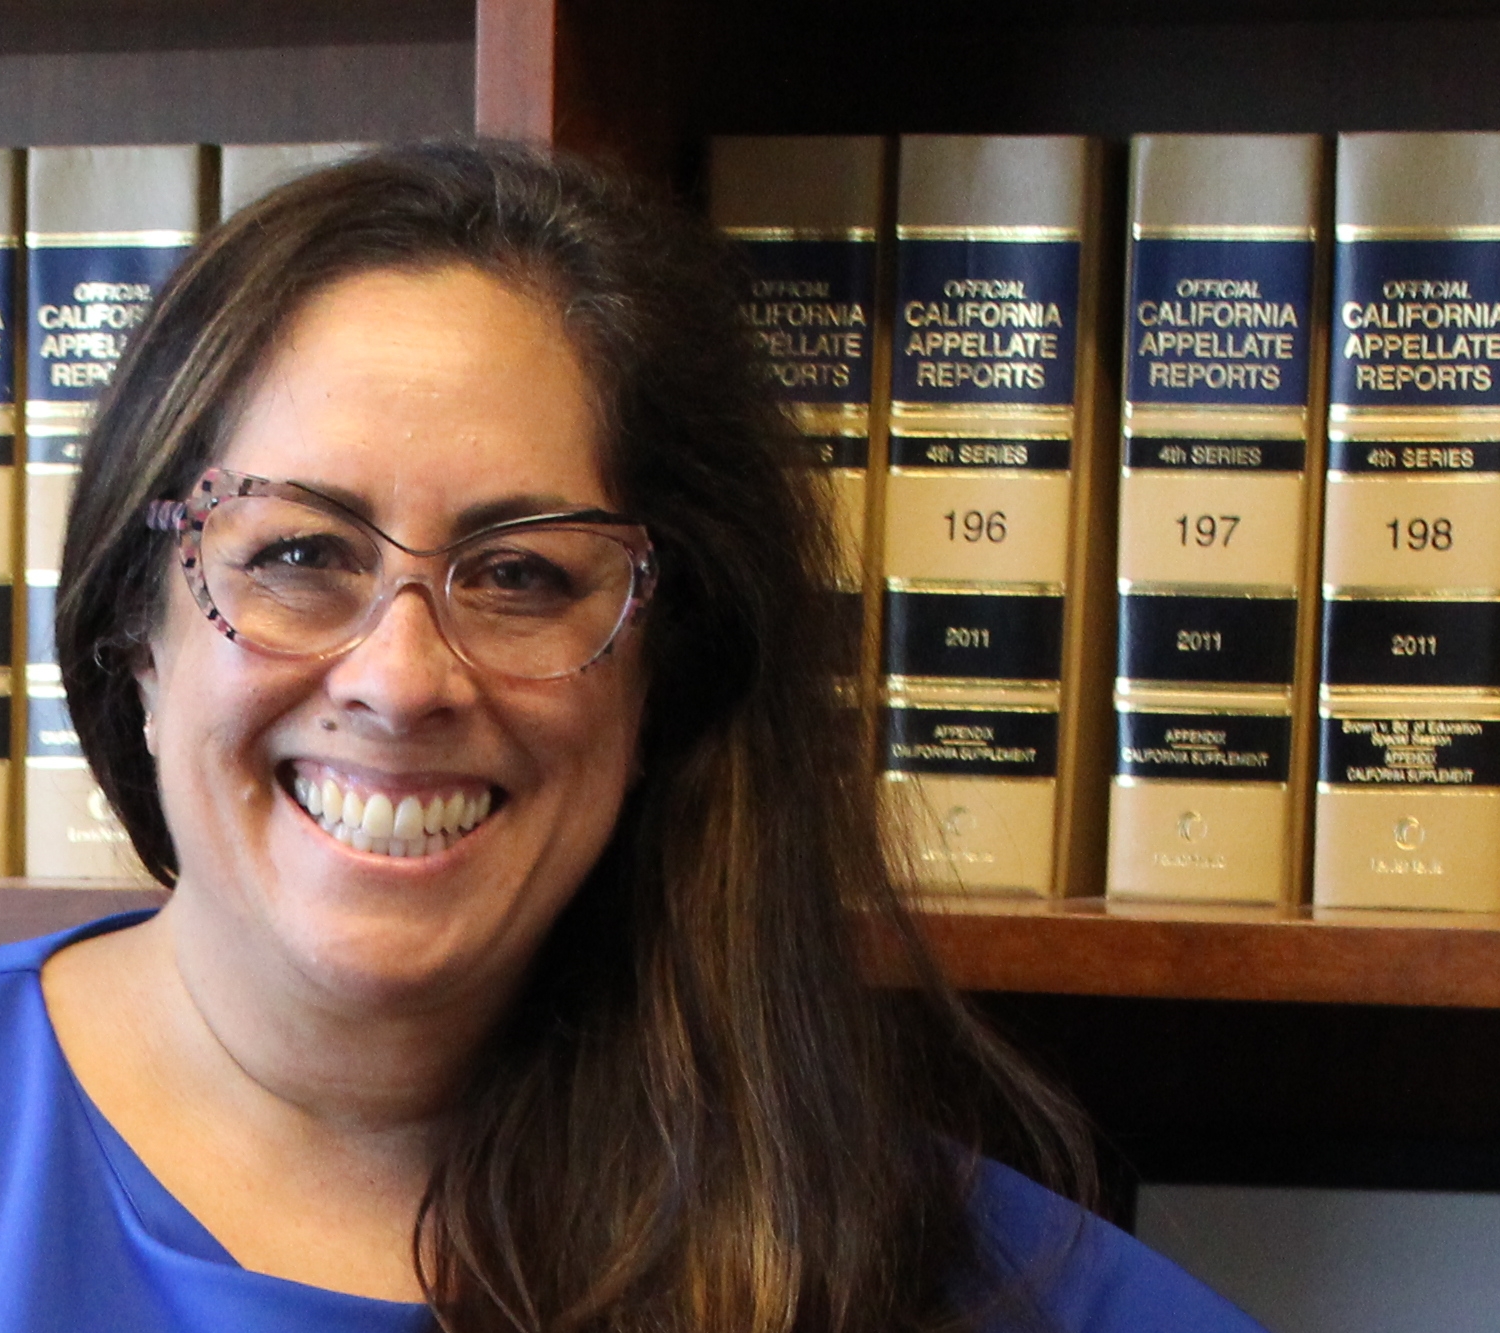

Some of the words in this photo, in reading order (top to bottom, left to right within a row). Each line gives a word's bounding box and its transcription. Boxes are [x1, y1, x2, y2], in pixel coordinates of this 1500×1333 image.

[944, 278, 1025, 300] OFFICIAL
[1177, 278, 1260, 300] OFFICIAL
[1383, 278, 1471, 300] OFFICIAL
[905, 302, 1061, 328] CALIFORNIA
[1139, 302, 1297, 328] CALIFORNIA
[907, 331, 1057, 359] APPELLATE
[1139, 331, 1292, 359] APPELLATE
[918, 361, 1045, 389] REPORTS
[1149, 361, 1279, 389] REPORTS
[1357, 362, 1492, 391] REPORTS
[927, 445, 953, 464] 4th
[960, 445, 1027, 464] SERIES
[1159, 447, 1186, 466] 4th
[1193, 447, 1261, 466] SERIES
[1368, 448, 1396, 468] 4th
[1403, 448, 1473, 469] SERIES
[942, 511, 1007, 542] 196
[1176, 514, 1240, 547] 197
[1385, 517, 1452, 551] 198
[946, 628, 990, 647] 2011
[1178, 630, 1221, 650] 2011
[1391, 634, 1436, 655] 2011
